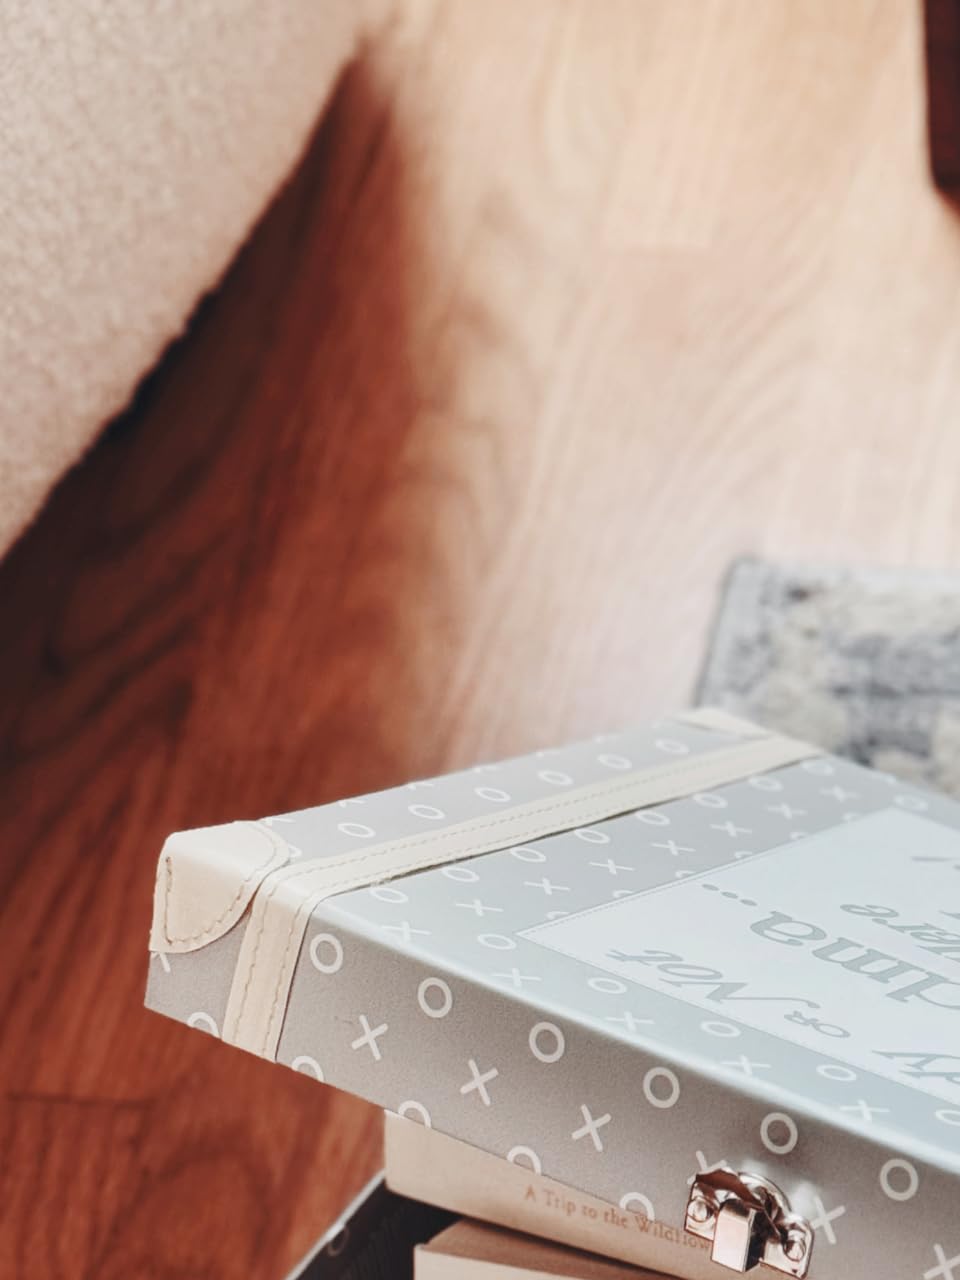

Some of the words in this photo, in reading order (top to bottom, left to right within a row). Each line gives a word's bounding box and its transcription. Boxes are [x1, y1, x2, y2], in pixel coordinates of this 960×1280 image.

[605, 950, 820, 1009] Not
[525, 1184, 536, 1200] A
[543, 1189, 576, 1216] Trip
[582, 1205, 599, 1219] to
[604, 1208, 629, 1229] the
